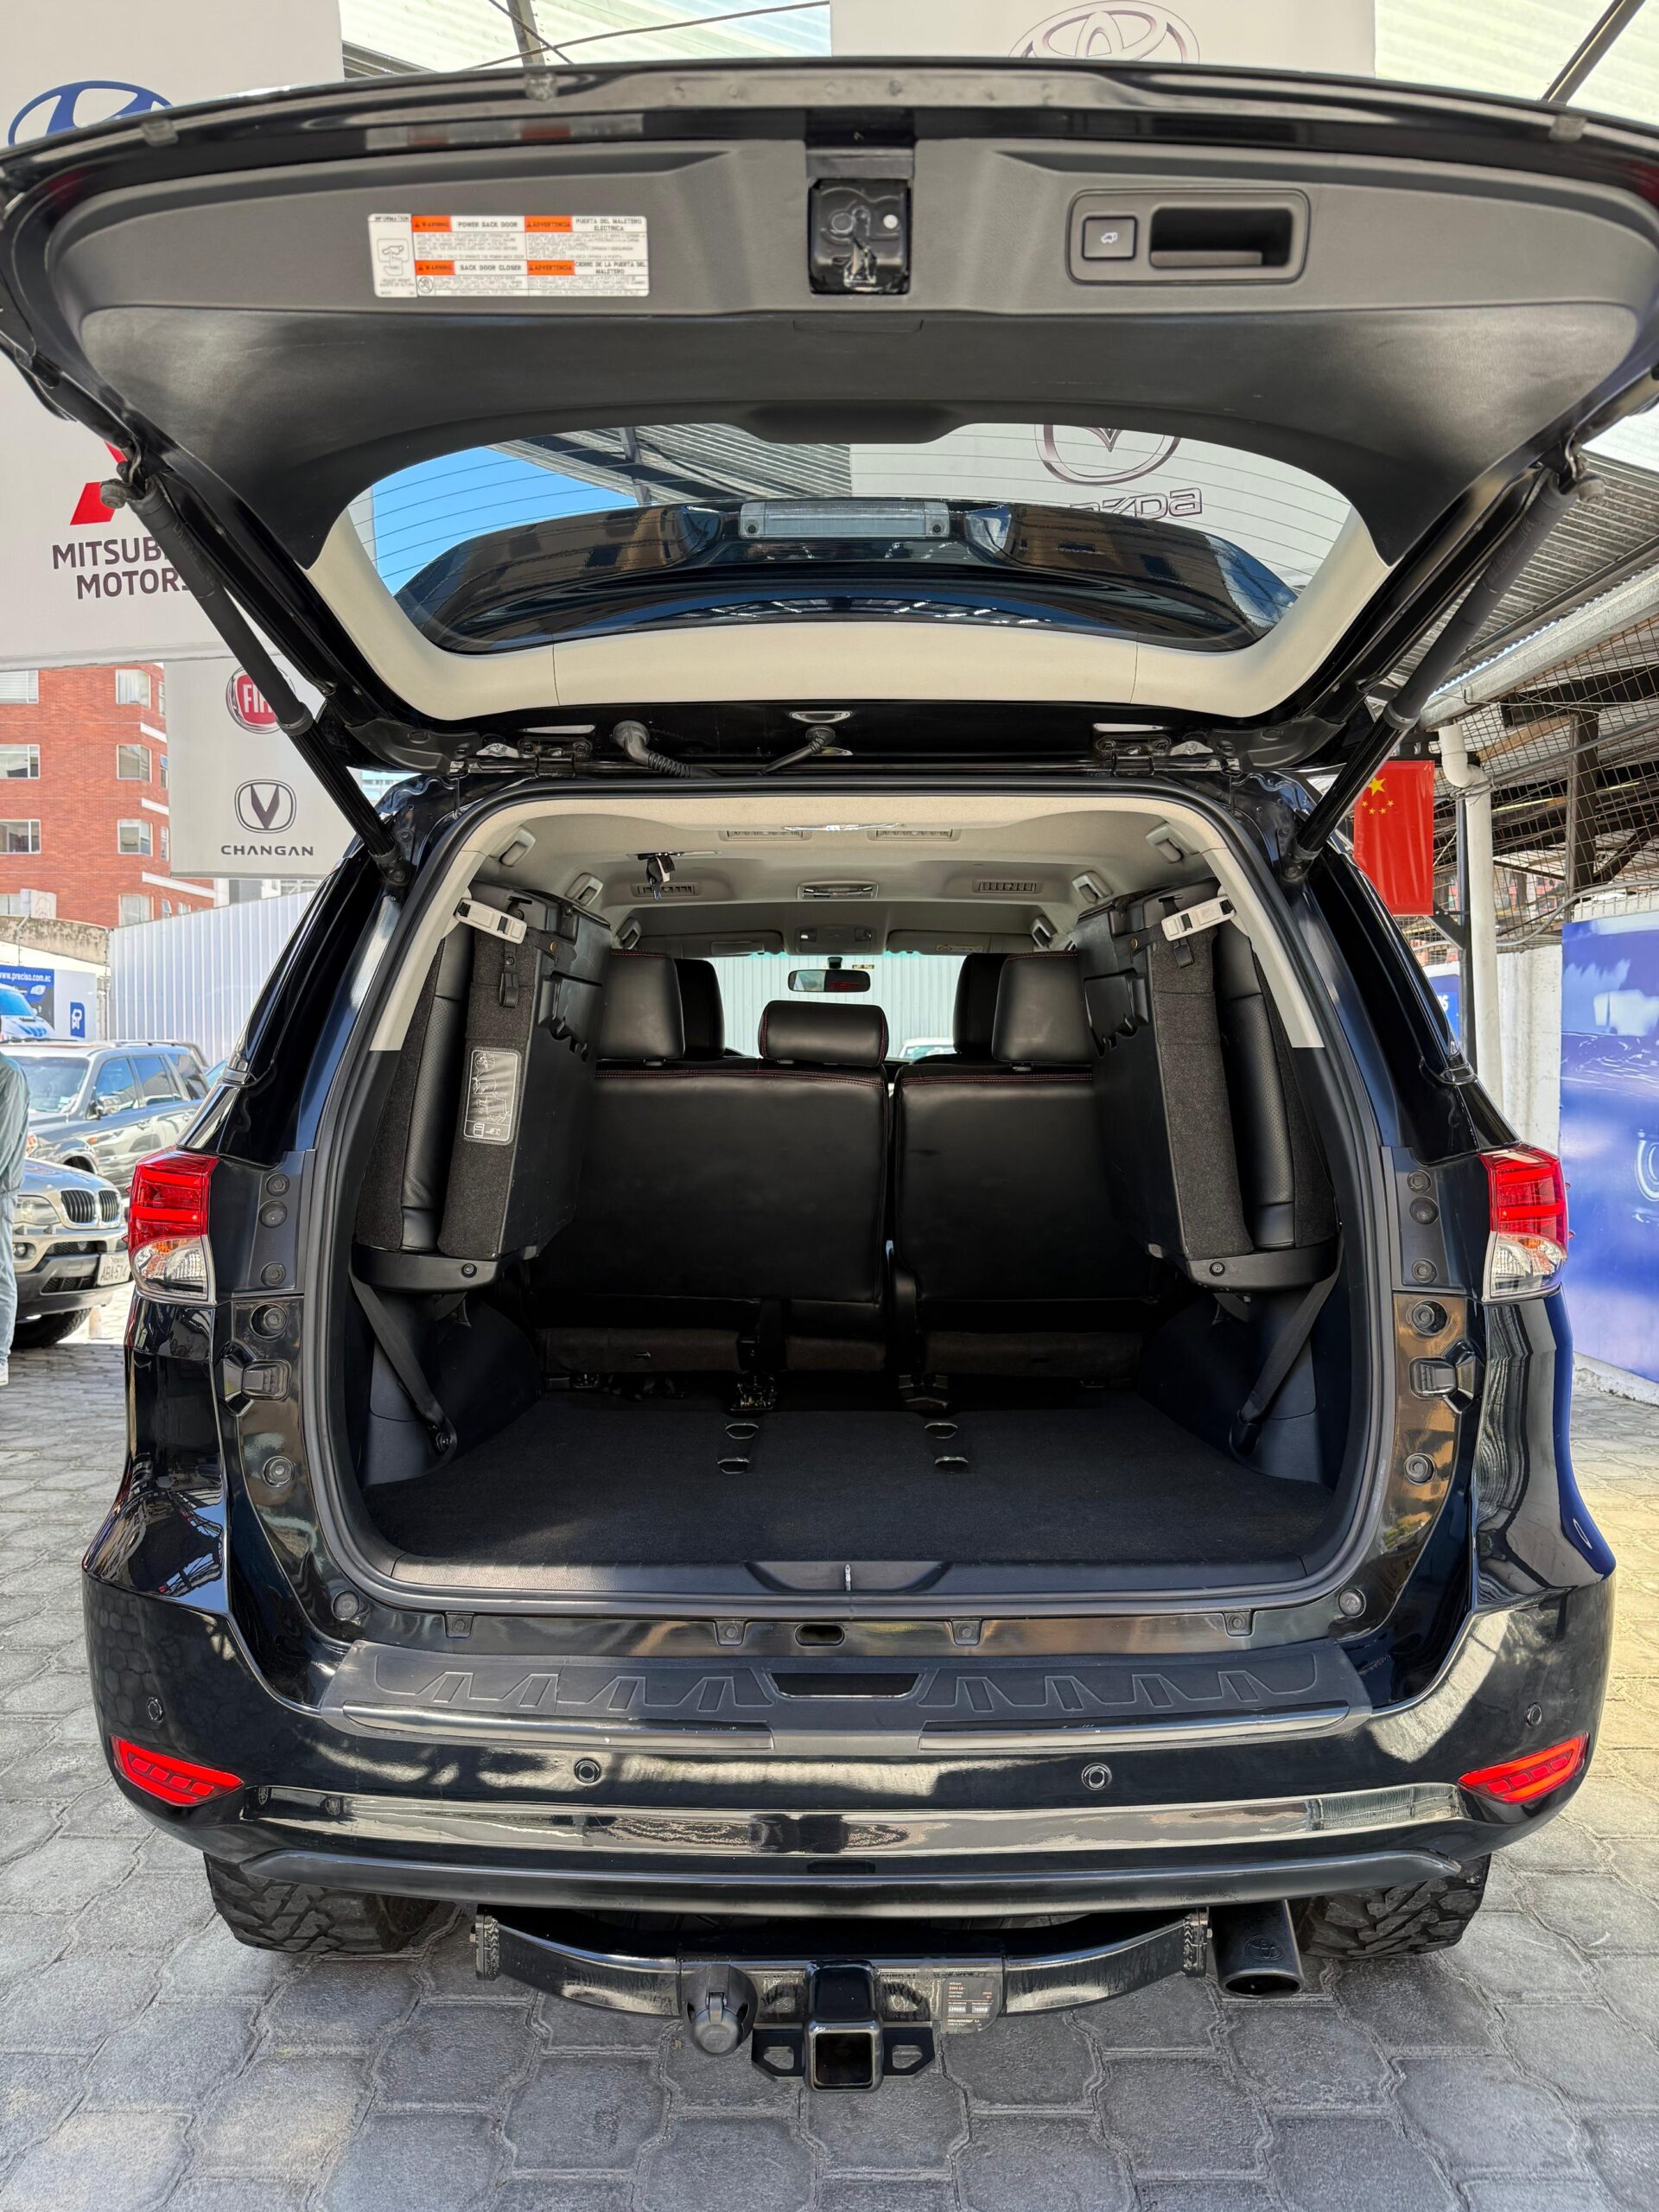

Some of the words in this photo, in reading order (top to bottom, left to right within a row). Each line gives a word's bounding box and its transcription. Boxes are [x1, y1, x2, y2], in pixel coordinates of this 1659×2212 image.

[52, 536, 168, 569] MITSUB
[76, 567, 190, 600] MOTOR
[220, 845, 315, 856] CHANGAN
